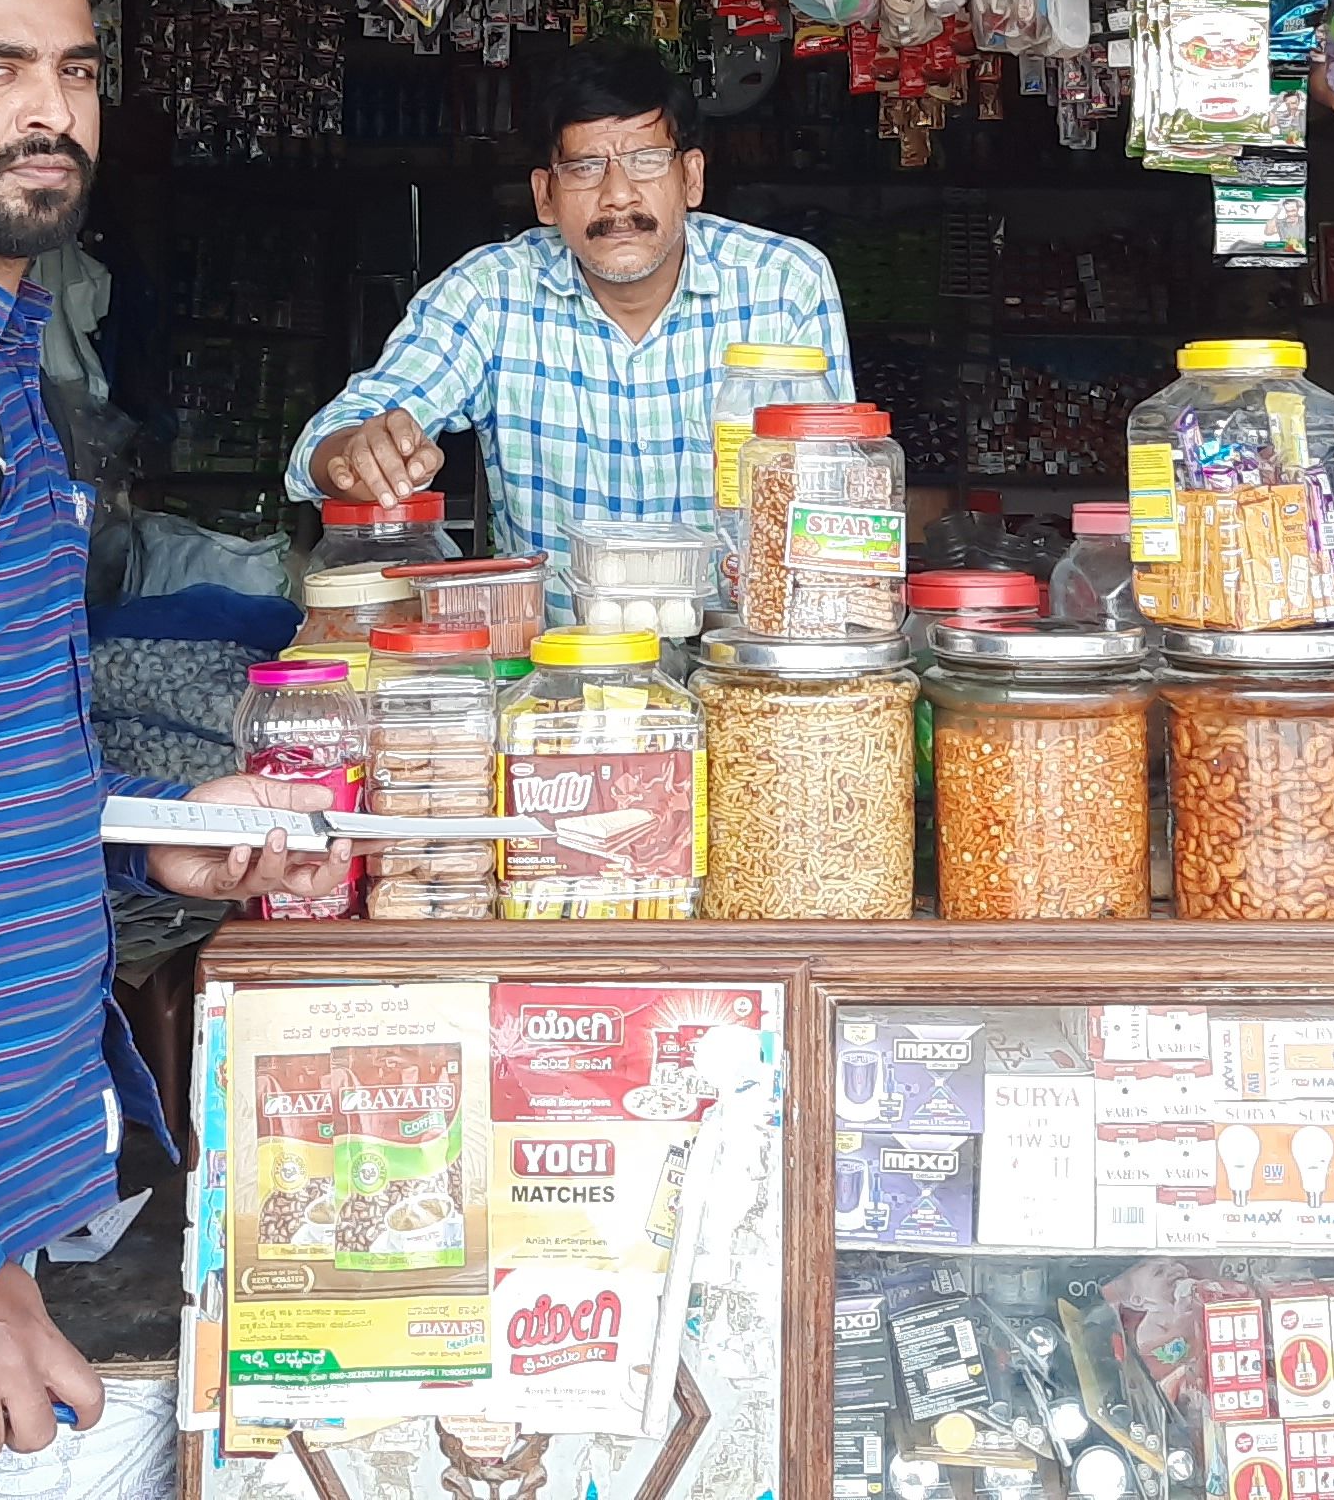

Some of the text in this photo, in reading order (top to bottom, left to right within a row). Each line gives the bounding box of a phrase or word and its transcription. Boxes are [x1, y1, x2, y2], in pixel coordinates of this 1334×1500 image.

[1216, 203, 1260, 216] EASY
[808, 515, 873, 537] STAR
[513, 772, 593, 813] Waffy
[527, 1010, 613, 1041] ಯೋಗಿ
[897, 1043, 969, 1060] MAXO
[358, 1085, 454, 1111] BAYAR'S
[995, 1086, 1080, 1108] SURYA
[521, 1142, 612, 1173] YOGI
[884, 1152, 955, 1170] MAXO
[1264, 1165, 1283, 1178] 9W
[511, 1185, 615, 1203] MATCHES
[507, 1290, 621, 1349] ಯೋಗಿ
